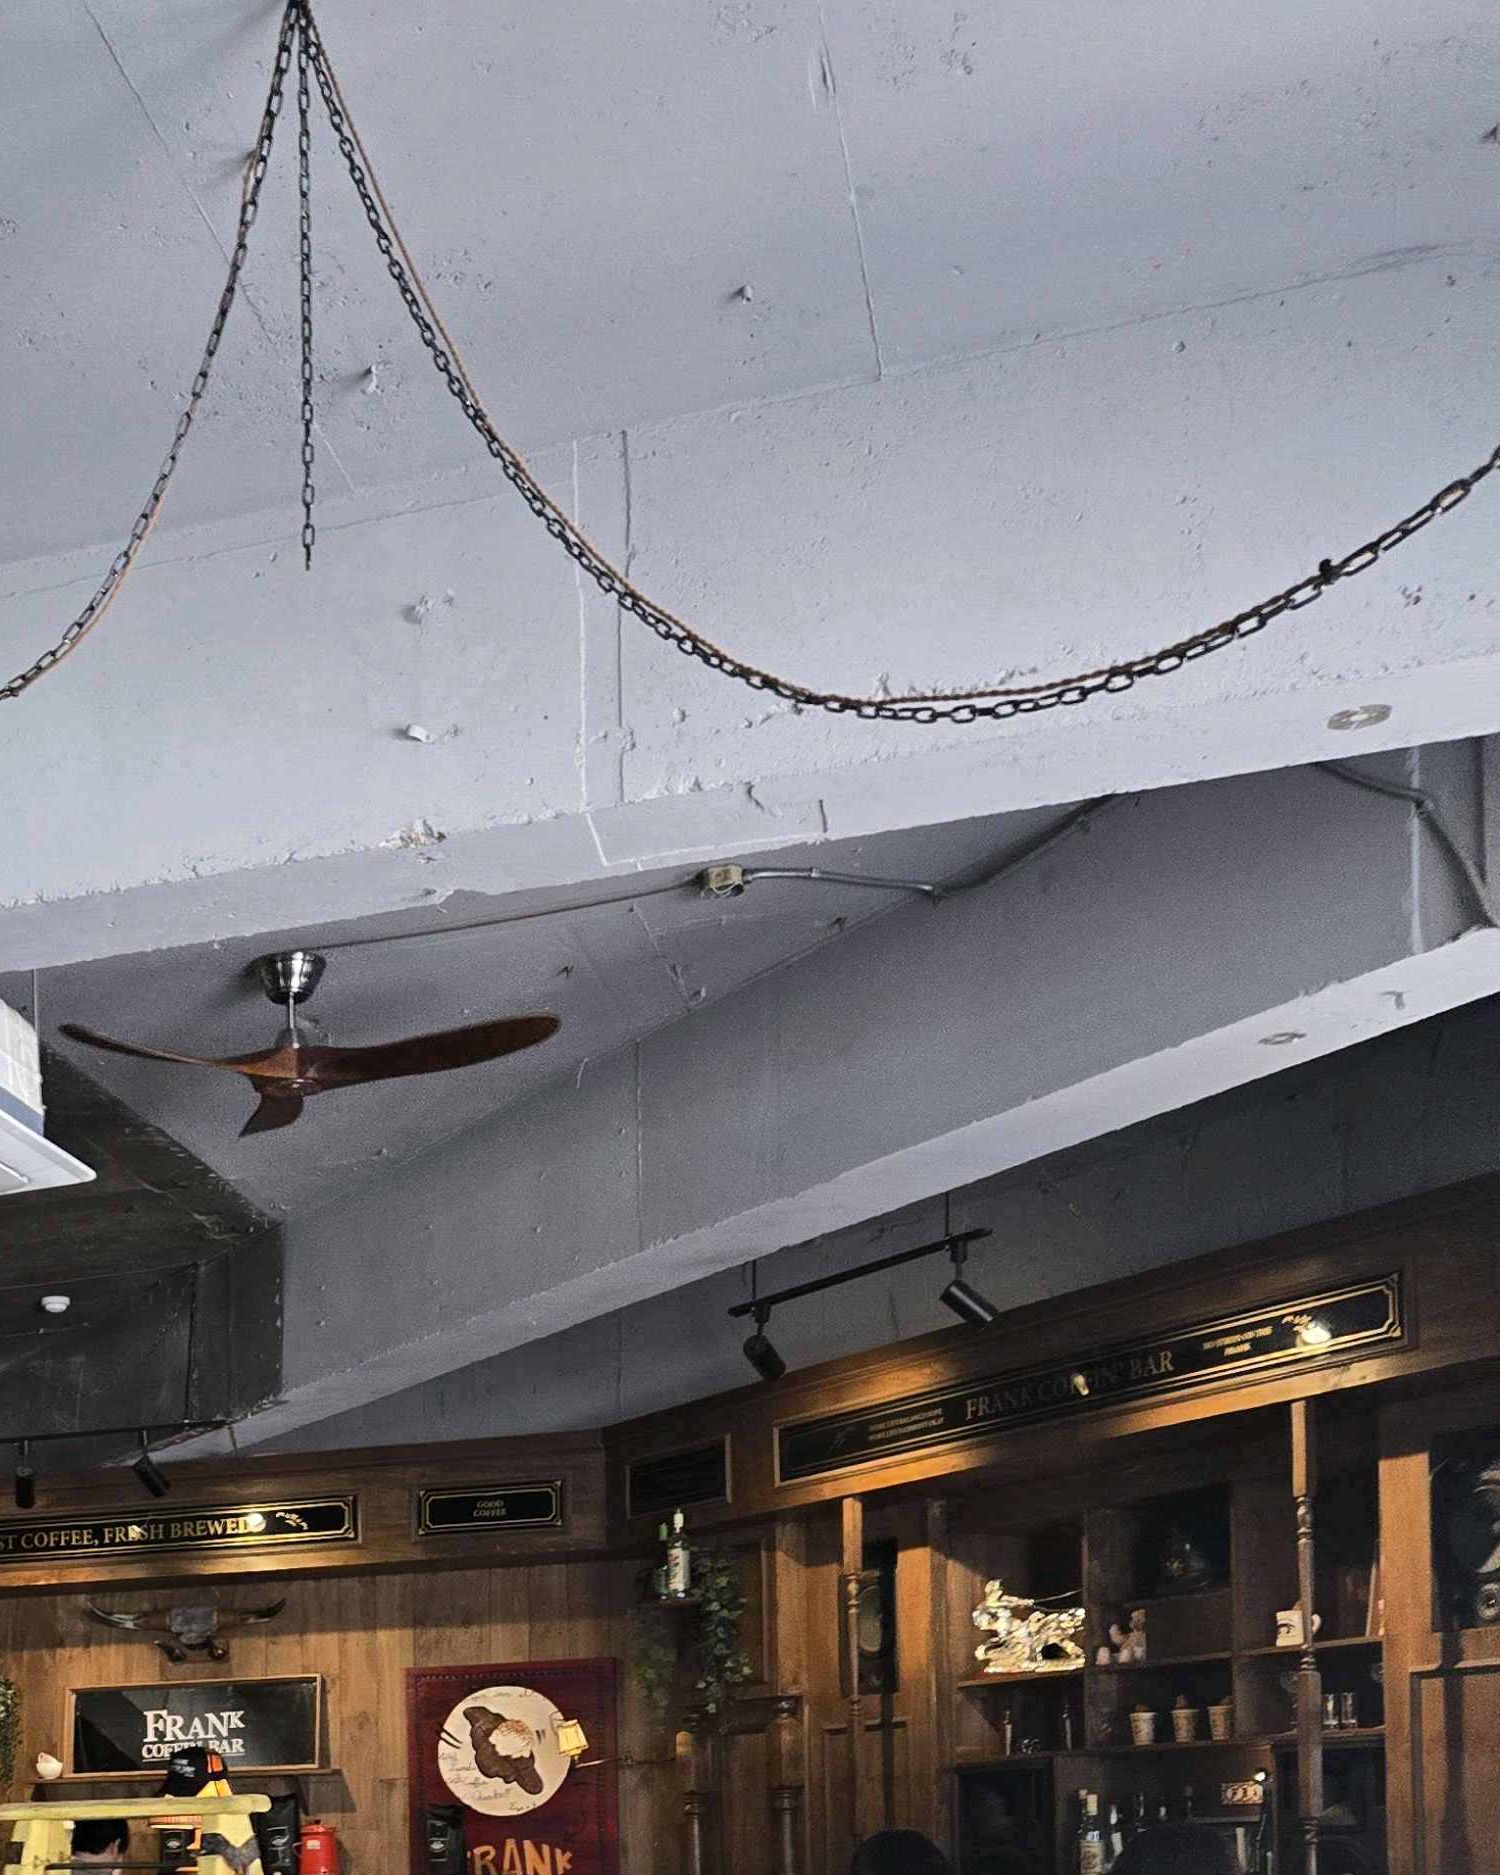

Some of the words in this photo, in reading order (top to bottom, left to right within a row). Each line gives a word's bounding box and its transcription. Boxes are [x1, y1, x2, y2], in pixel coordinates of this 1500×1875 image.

[964, 1385, 1033, 1420] FRANK
[1129, 1350, 1175, 1380] BAR
[473, 1508, 507, 1517] COFFEE
[476, 1500, 504, 1508] GOOD
[21, 1528, 99, 1549] COFFEE,
[104, 1523, 164, 1544] FRESH
[170, 1517, 254, 1539] BREWED
[143, 1709, 246, 1743] FRANK
[207, 1738, 245, 1756] BAR
